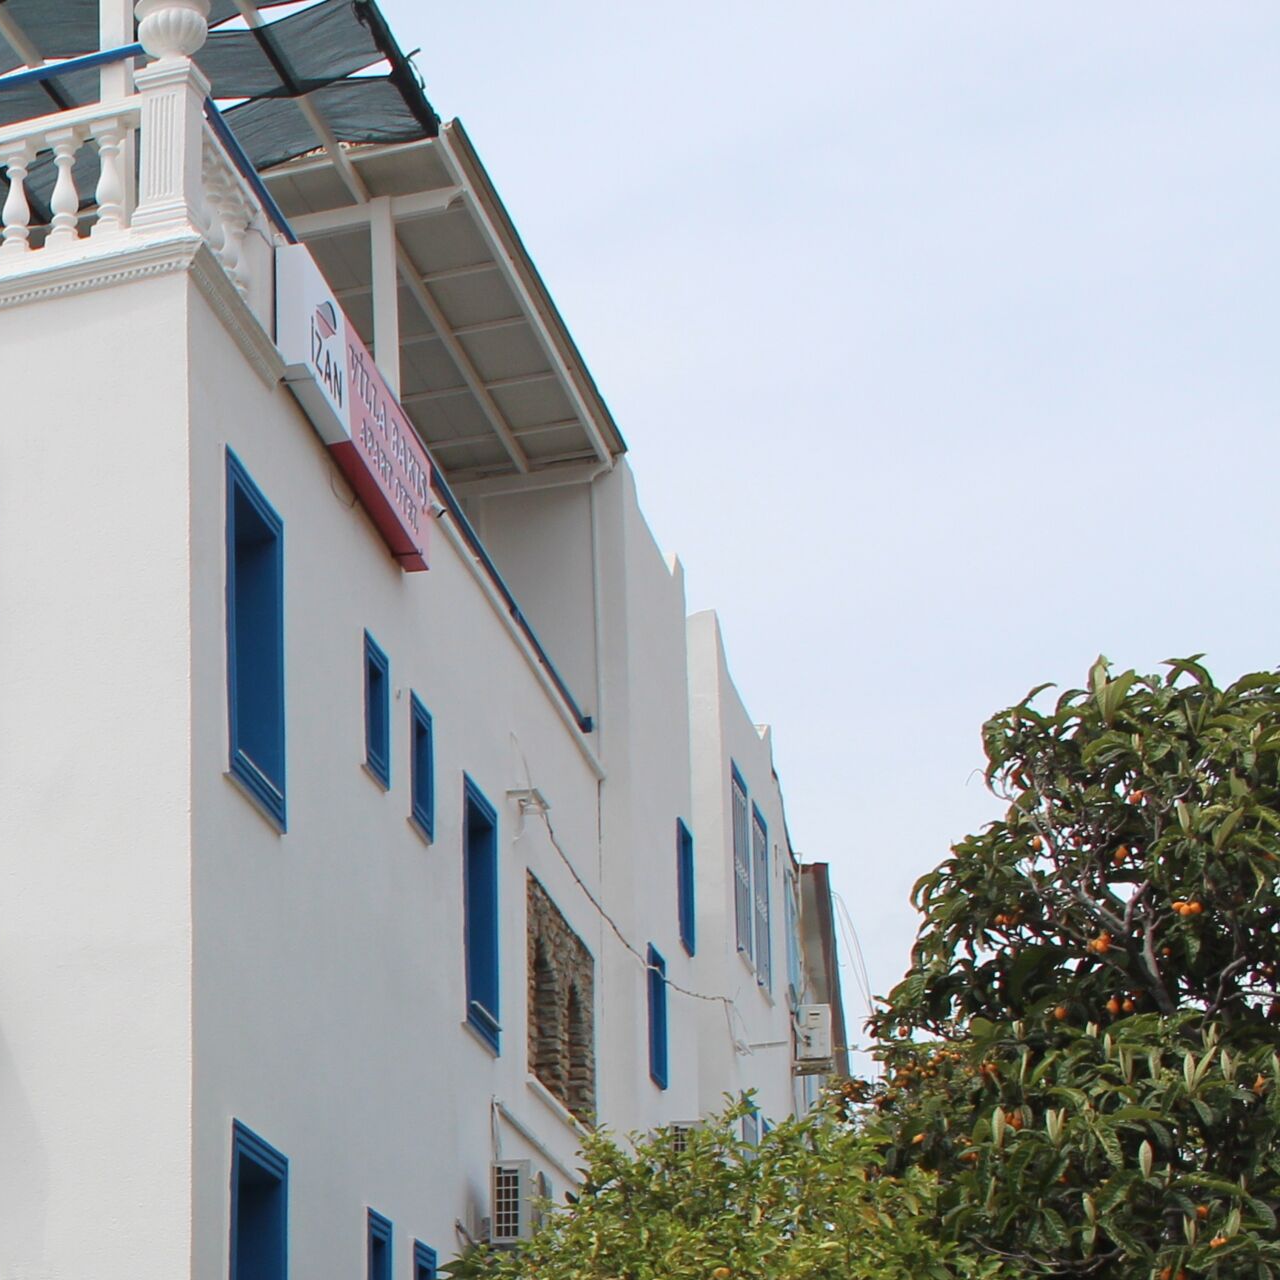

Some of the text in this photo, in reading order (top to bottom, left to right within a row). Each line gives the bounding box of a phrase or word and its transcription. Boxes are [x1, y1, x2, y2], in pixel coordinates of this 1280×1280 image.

[310, 314, 343, 408] İZAN
[359, 417, 420, 535] APART OTEL
